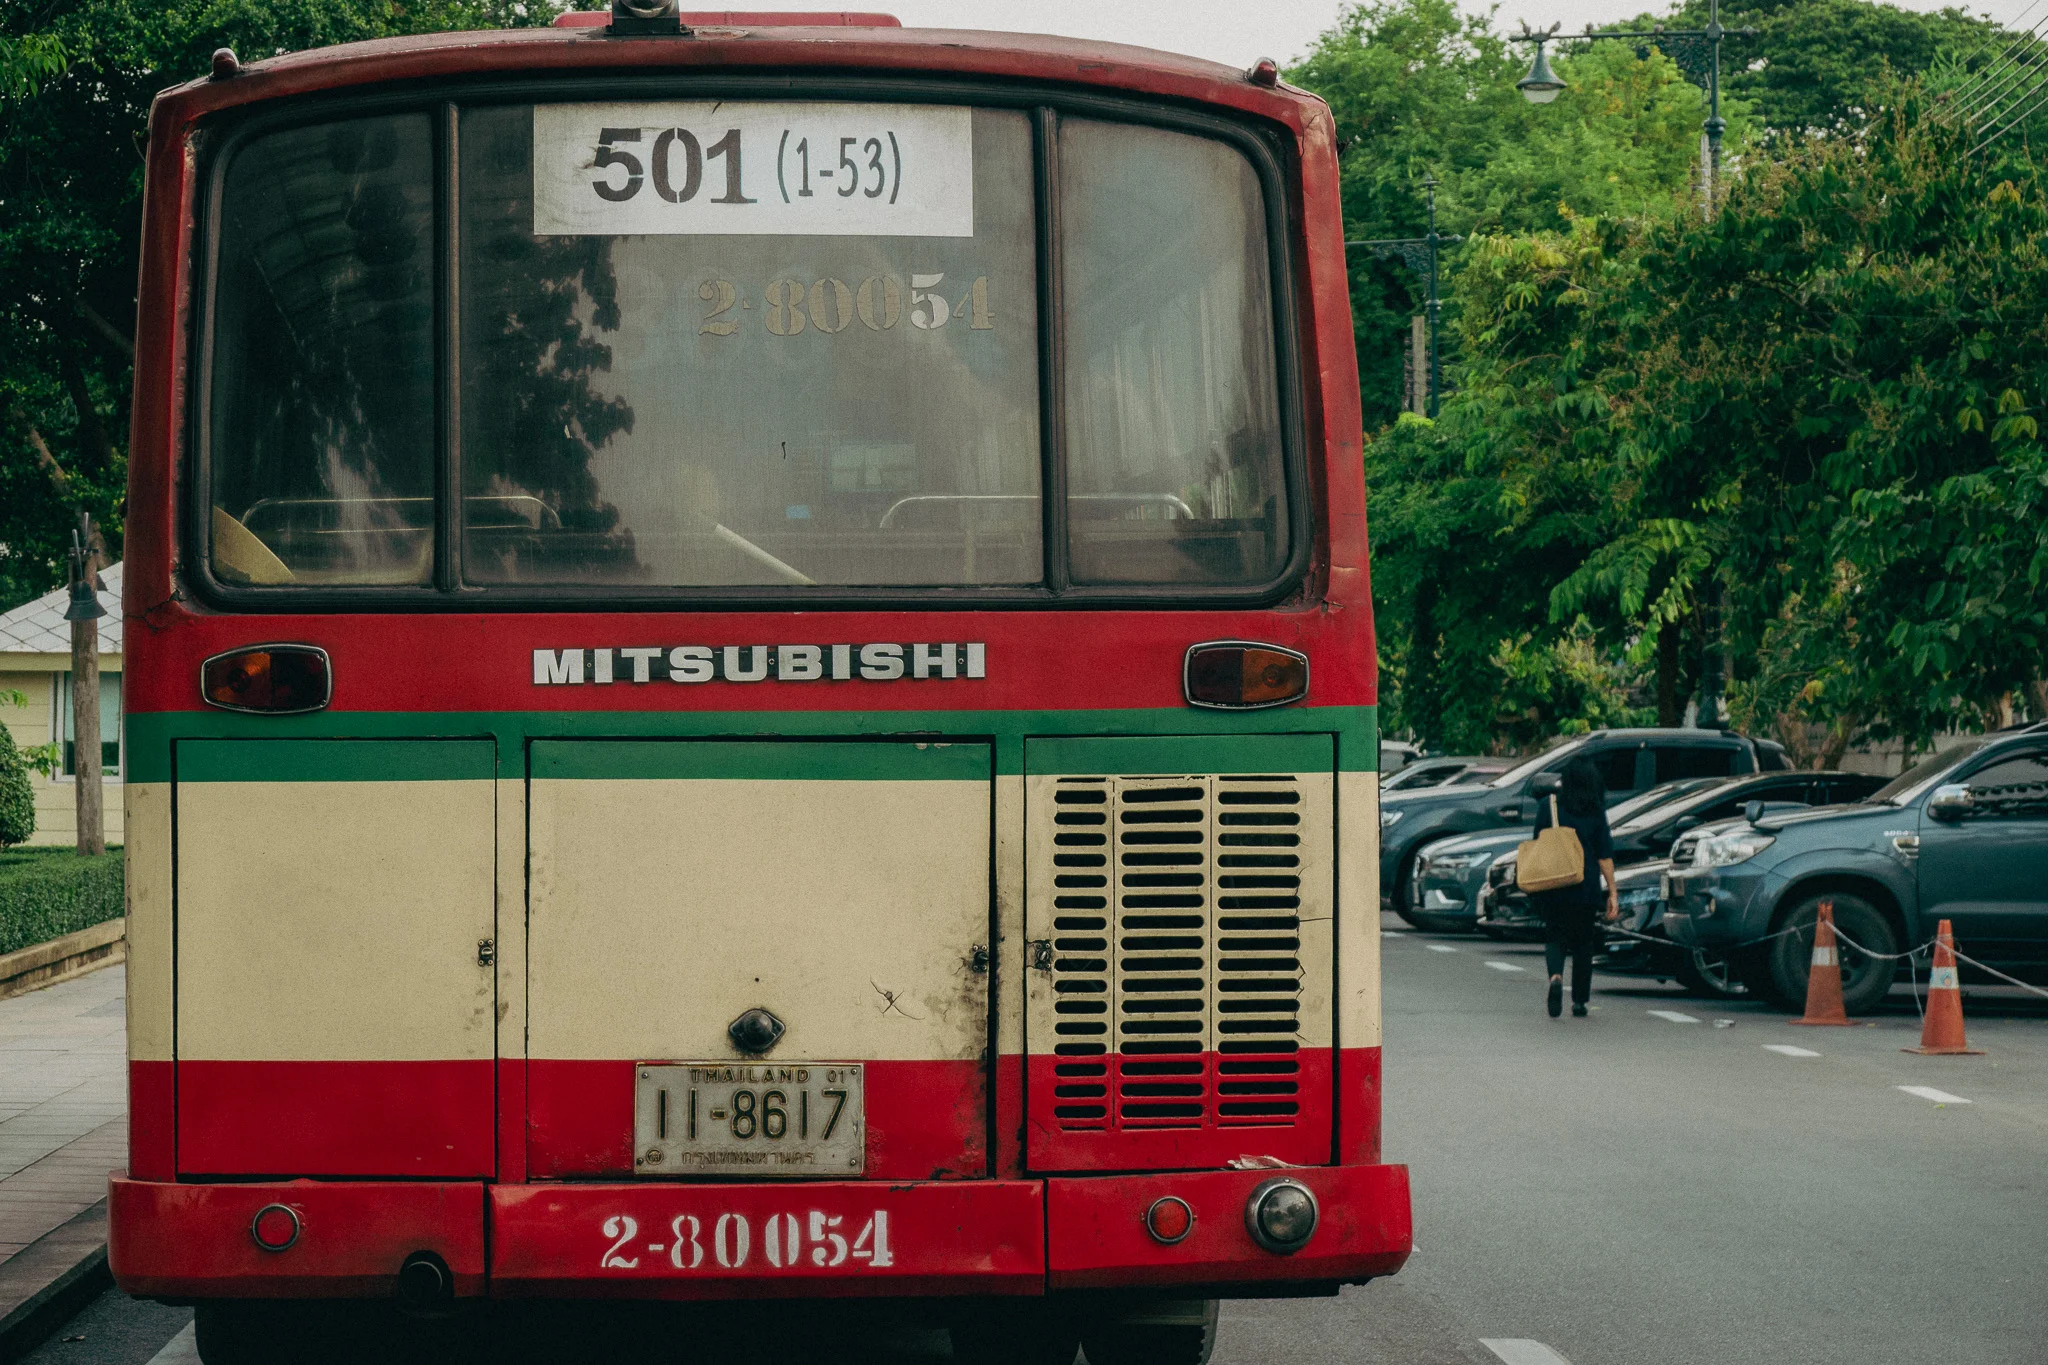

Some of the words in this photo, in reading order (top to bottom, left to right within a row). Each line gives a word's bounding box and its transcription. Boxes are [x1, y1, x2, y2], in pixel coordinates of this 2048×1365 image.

[591, 127, 758, 204] 501
[777, 129, 901, 205] (1-53)
[698, 272, 996, 337] 2-80054
[532, 642, 986, 684] MITSUBISHI
[689, 1067, 811, 1084] THAILAND
[825, 1068, 846, 1084] 01
[657, 1088, 850, 1141] 11-8617
[601, 1210, 894, 1268] 2-80054
